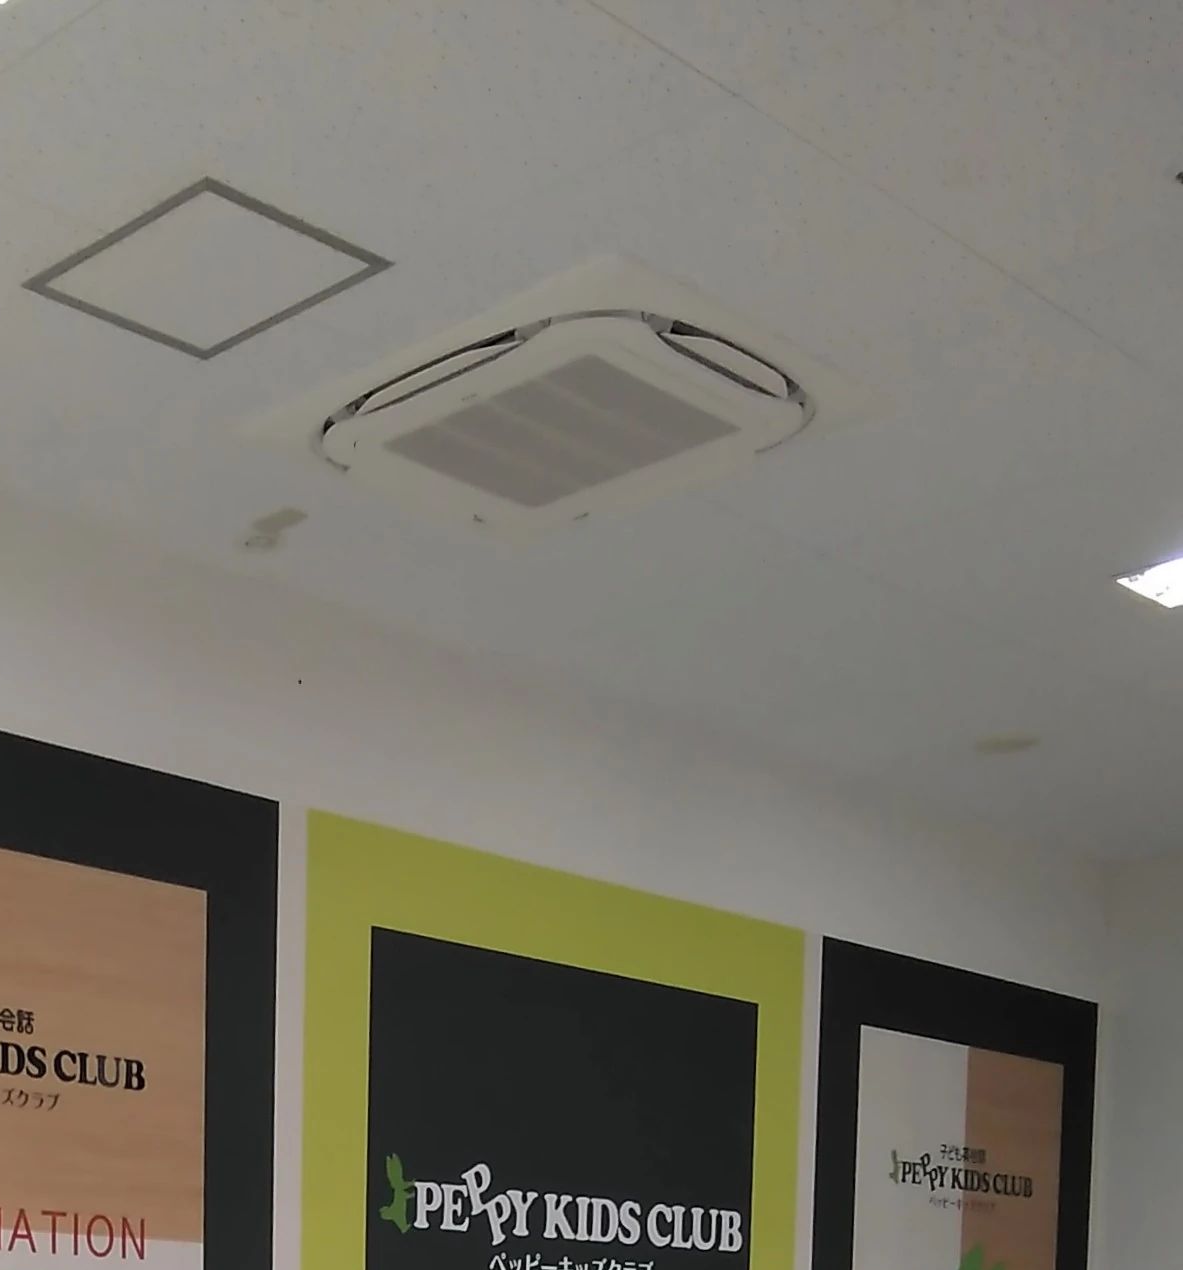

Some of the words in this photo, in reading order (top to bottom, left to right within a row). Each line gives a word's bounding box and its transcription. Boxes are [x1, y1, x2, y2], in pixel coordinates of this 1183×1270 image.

[53, 1049, 146, 1091] CLUB
[901, 1152, 949, 1191] PEPPY
[951, 1168, 990, 1193] KIDS
[993, 1173, 1033, 1198] CLUB
[414, 1163, 538, 1246] PEPPY
[543, 1193, 642, 1244] KIDS
[646, 1203, 743, 1252] CLUB
